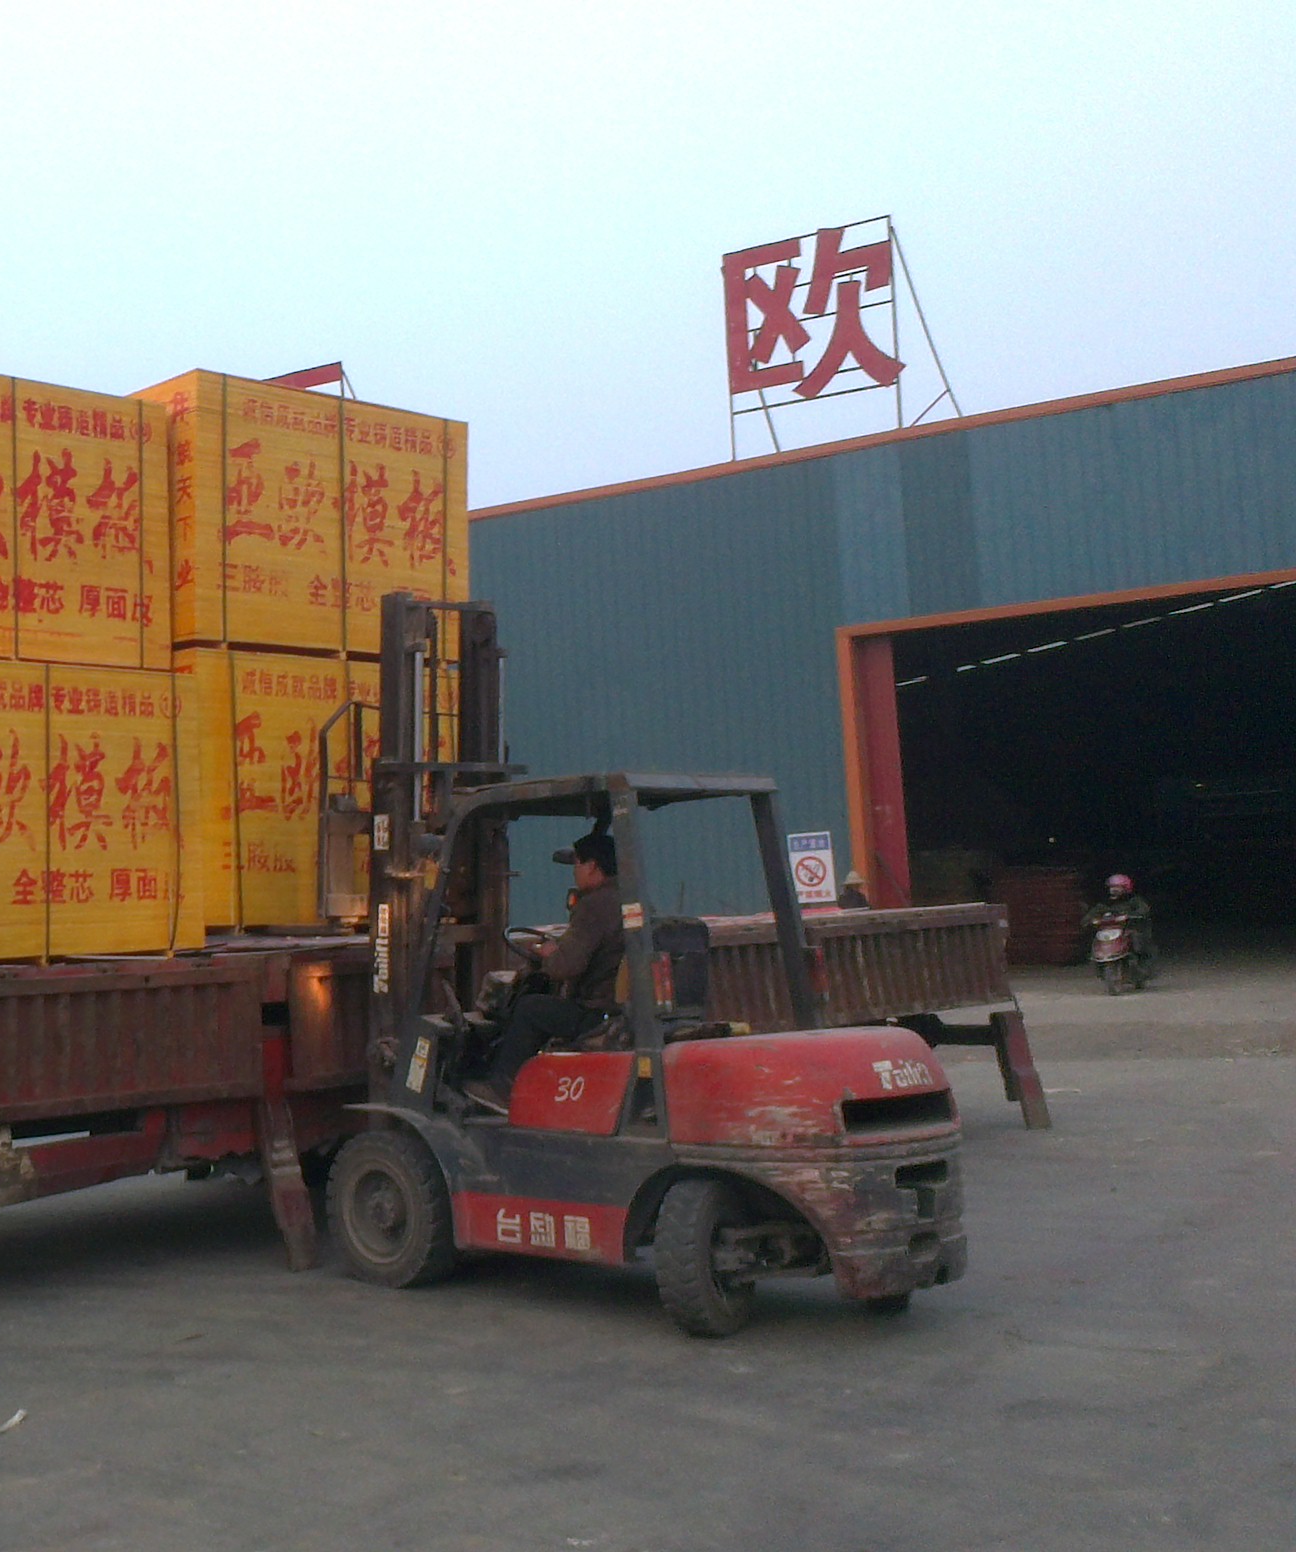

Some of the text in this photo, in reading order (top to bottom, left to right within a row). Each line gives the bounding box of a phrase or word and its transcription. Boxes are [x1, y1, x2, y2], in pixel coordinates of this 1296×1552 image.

[720, 227, 907, 399] 欧
[10, 868, 95, 905] 全整芯
[554, 1075, 585, 1102] 30
